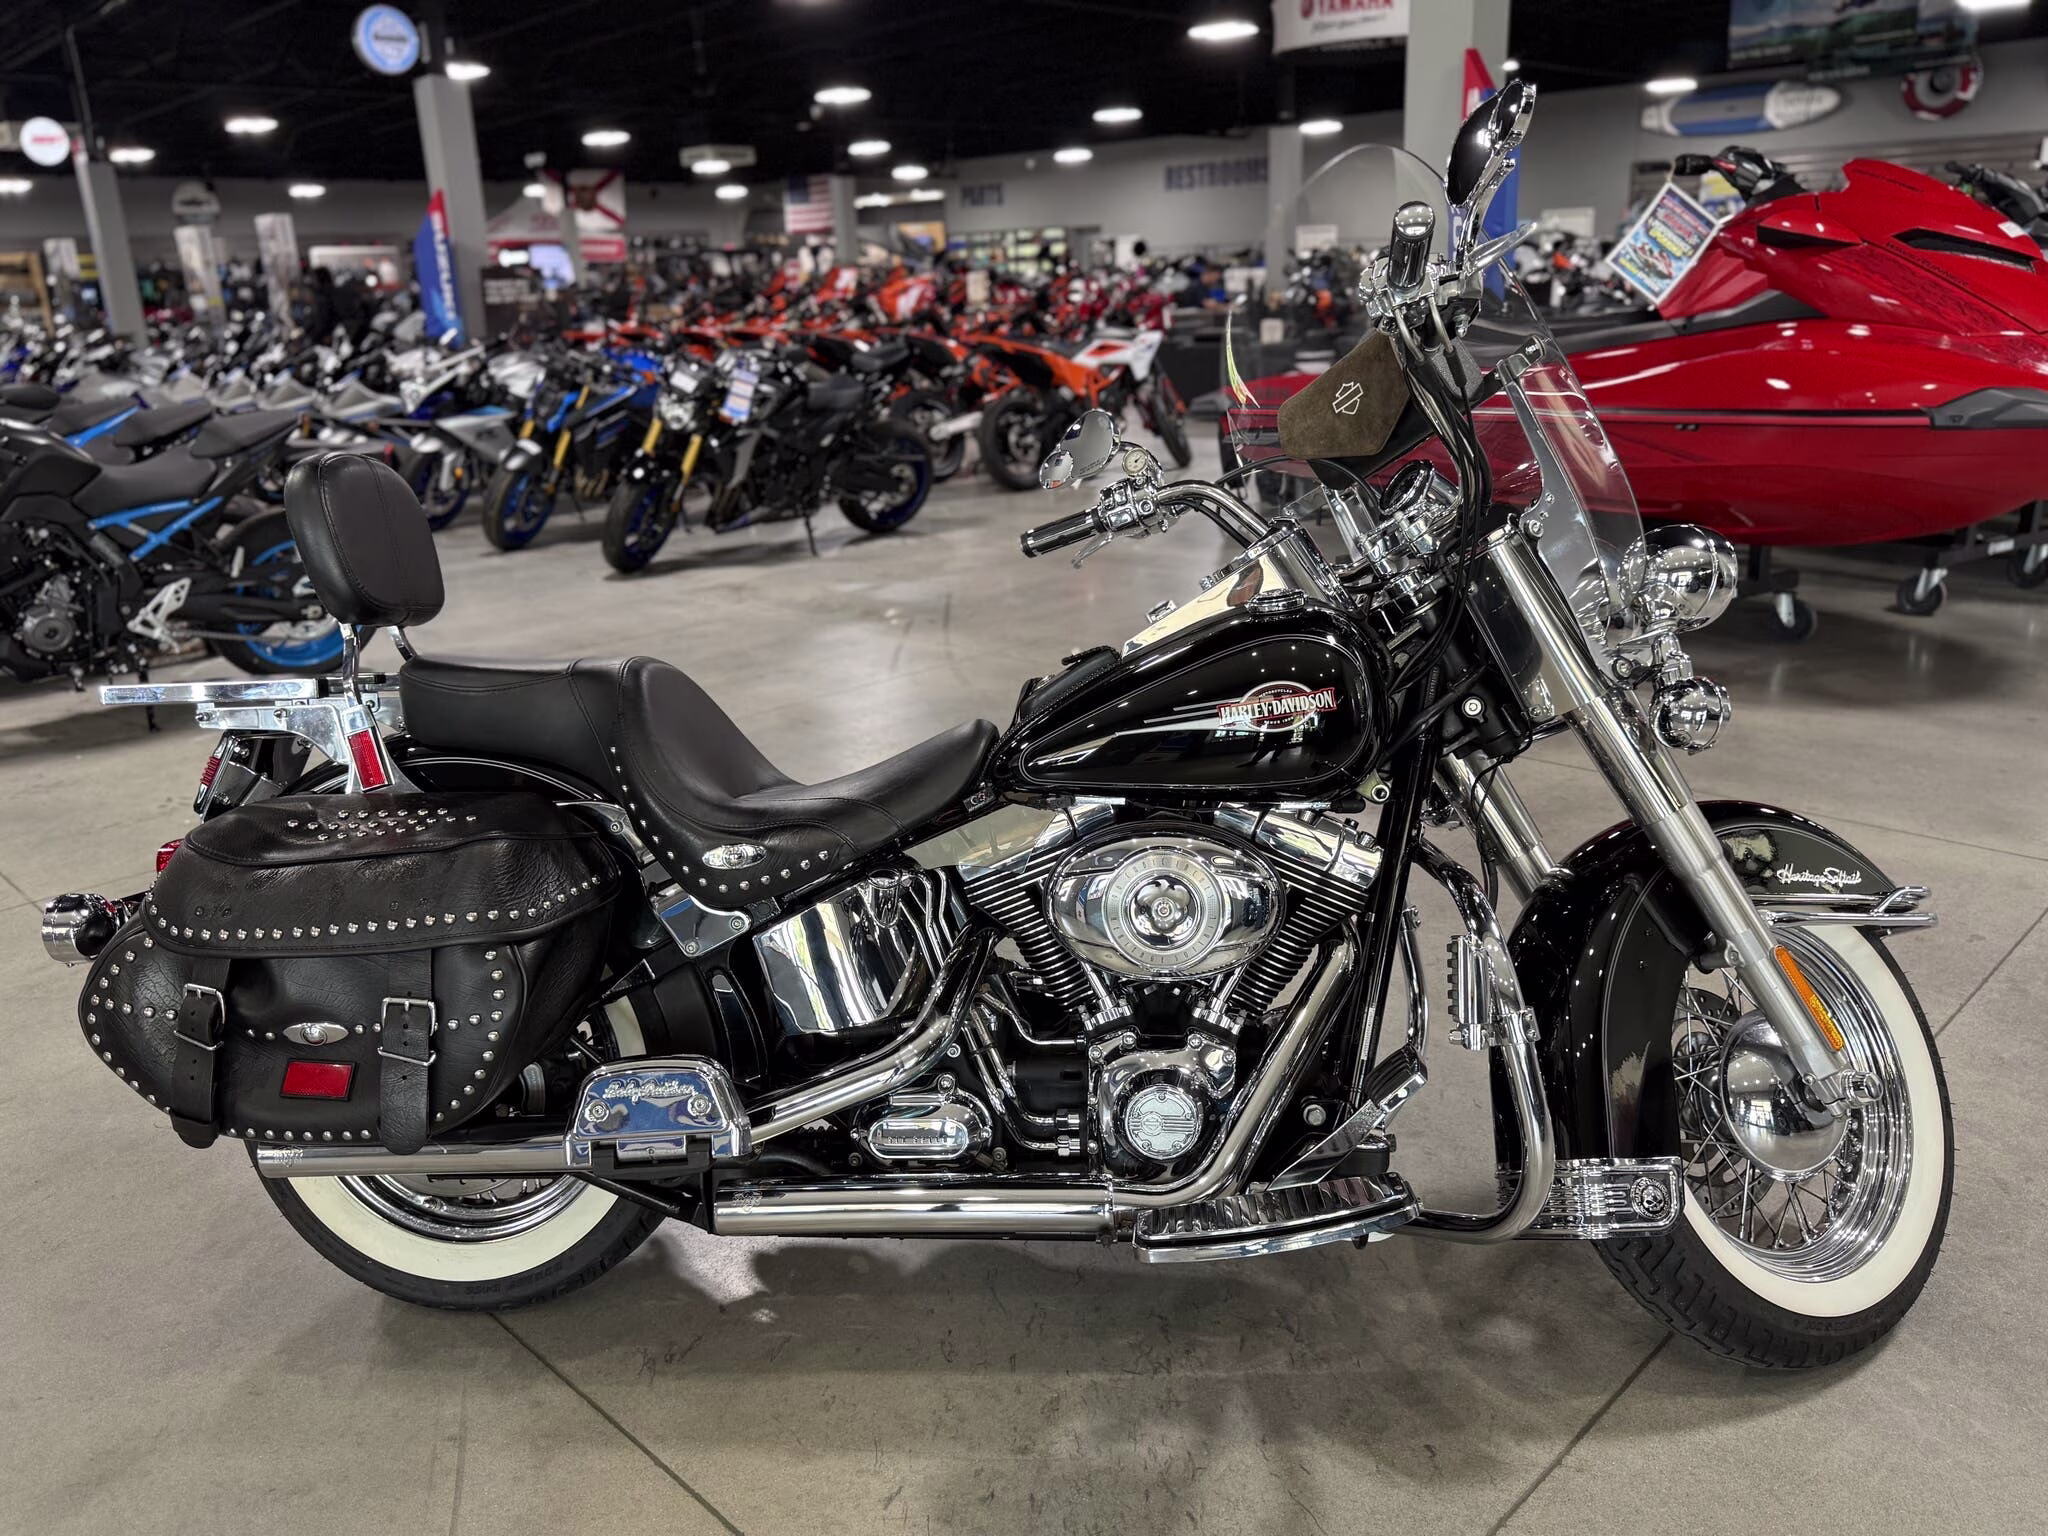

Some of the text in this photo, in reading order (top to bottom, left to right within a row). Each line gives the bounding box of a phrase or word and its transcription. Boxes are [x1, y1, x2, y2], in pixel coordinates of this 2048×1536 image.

[1165, 157, 1269, 190] RESTROOMS
[960, 183, 1005, 207] PARTS
[1776, 863, 1862, 888] Heritage Softail
